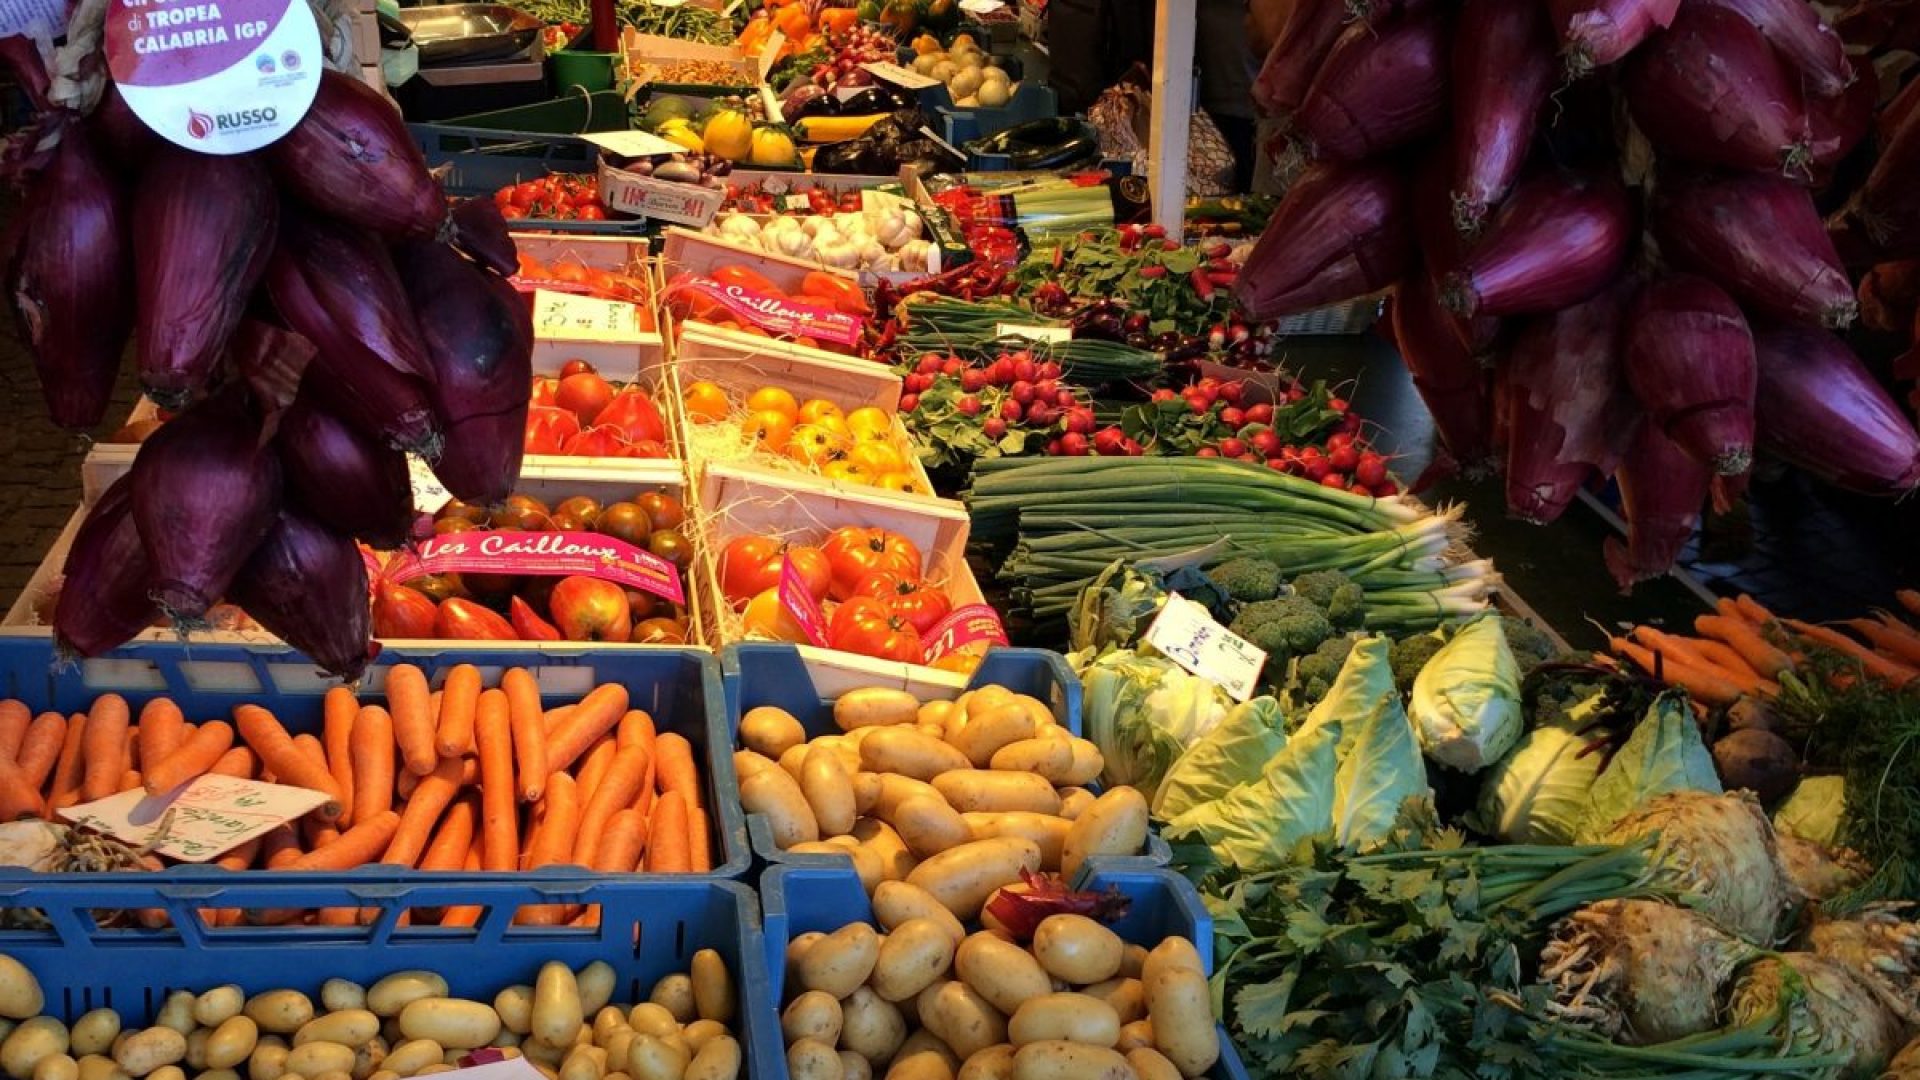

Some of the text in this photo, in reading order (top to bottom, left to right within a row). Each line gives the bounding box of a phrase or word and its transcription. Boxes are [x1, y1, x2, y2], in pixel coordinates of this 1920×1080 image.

[128, 3, 222, 31] di TROPEA
[134, 20, 267, 53] CALABRIA IGP
[216, 107, 277, 129] RUSSO
[421, 535, 622, 561] Les Cailloux
